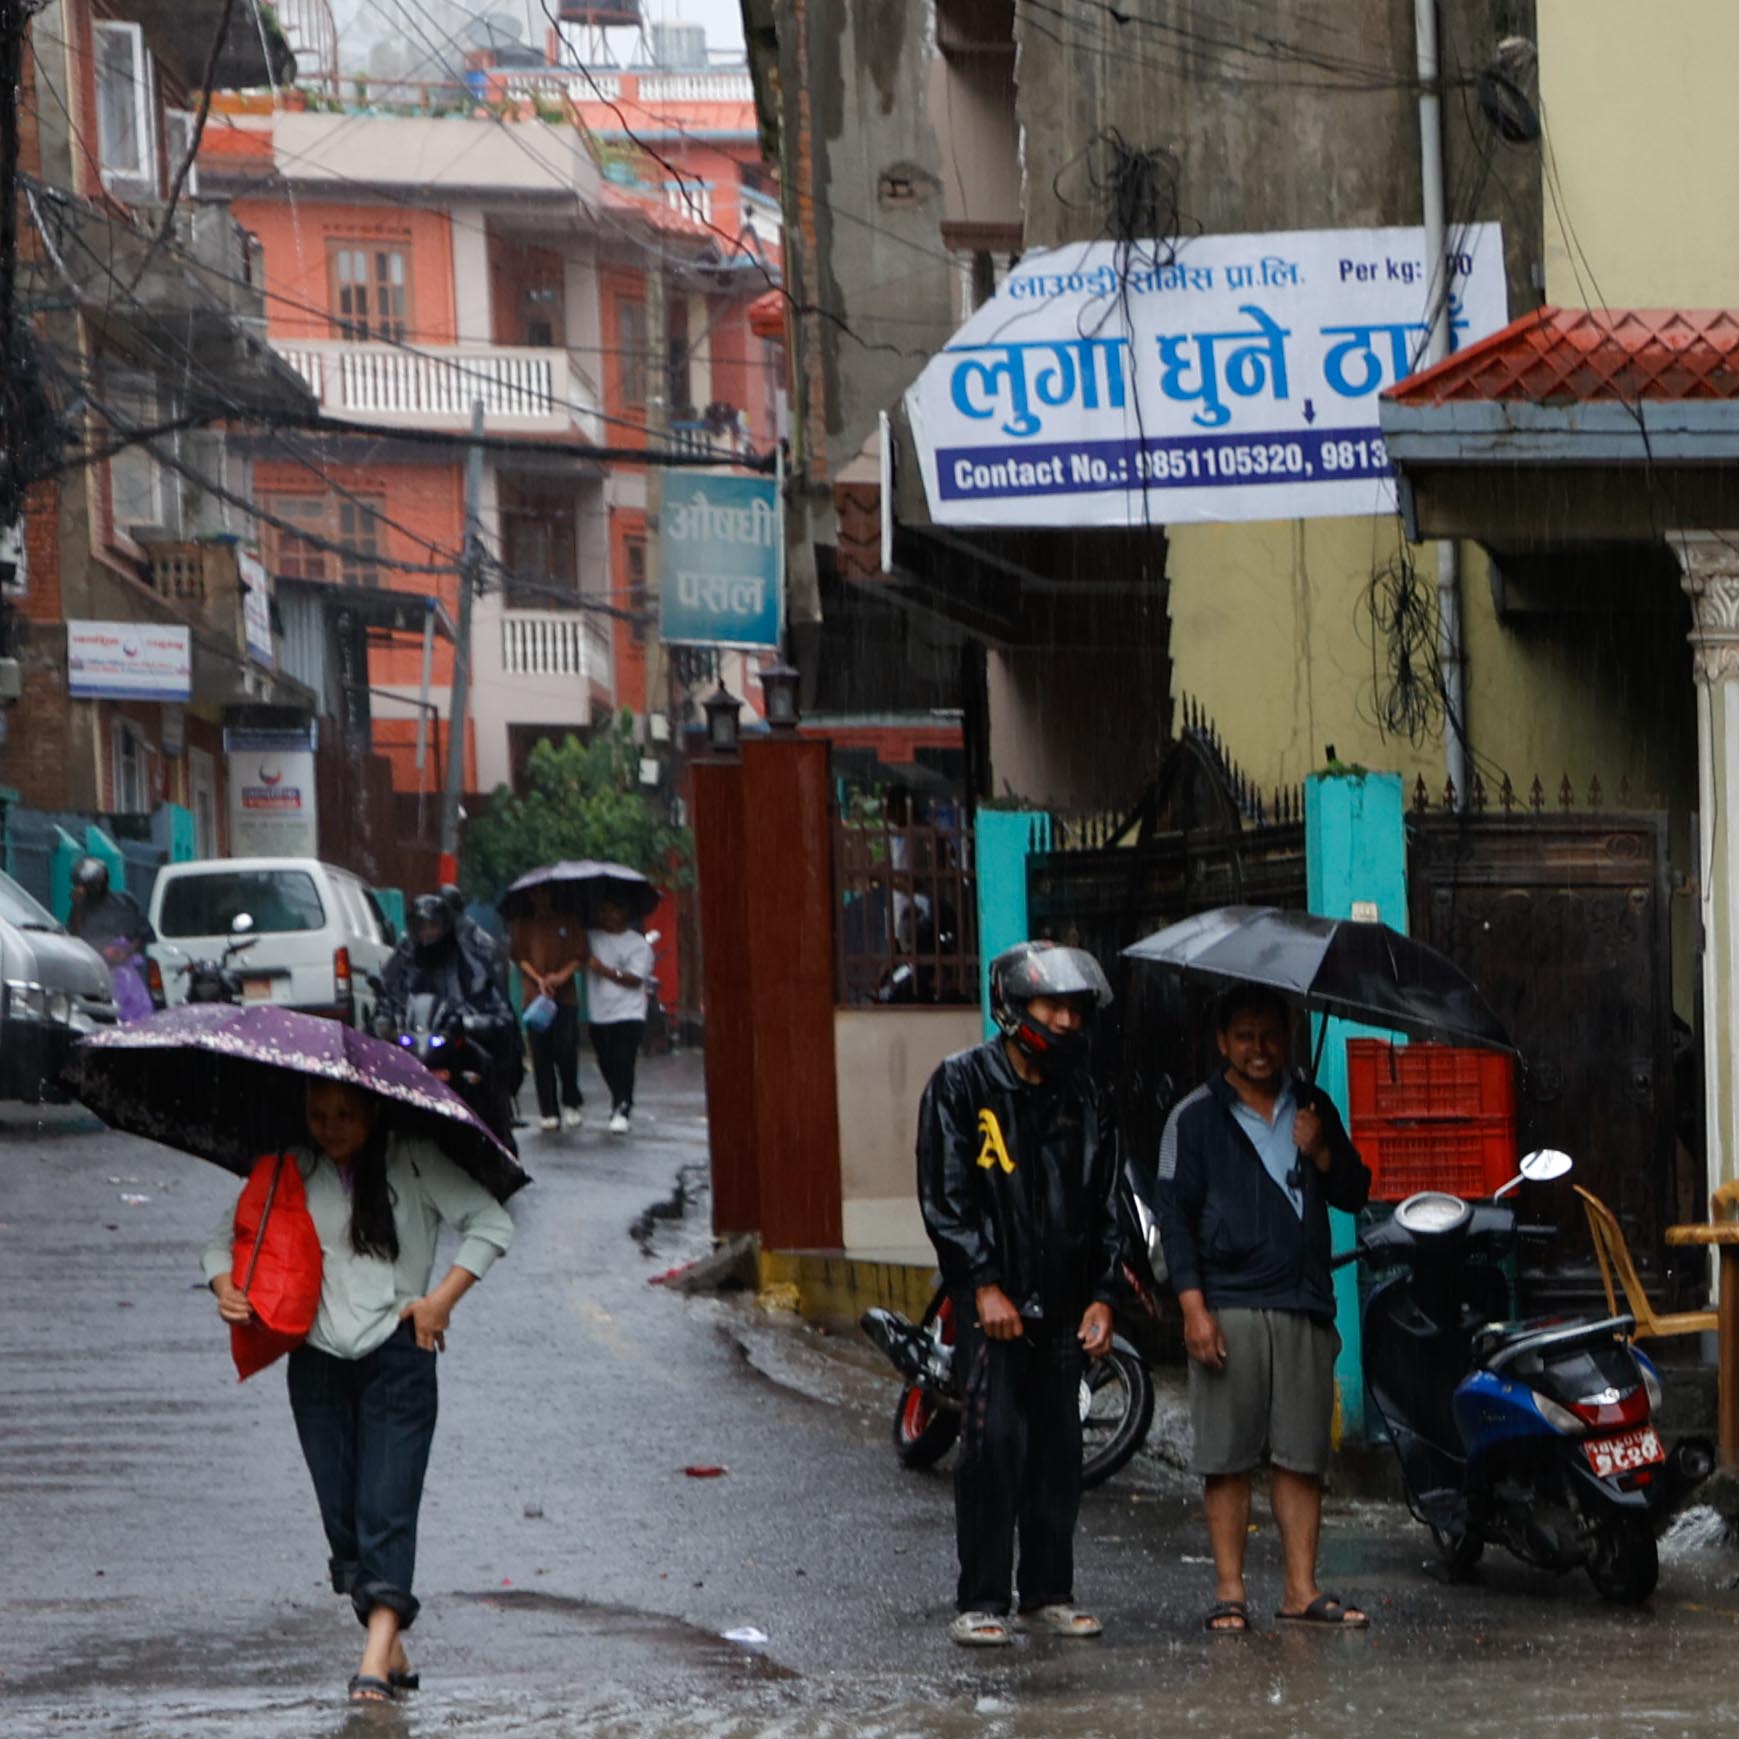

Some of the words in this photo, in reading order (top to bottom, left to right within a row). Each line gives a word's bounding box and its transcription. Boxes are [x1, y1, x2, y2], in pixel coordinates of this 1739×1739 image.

[1339, 259, 1378, 282] Per
[1386, 258, 1422, 284] kg:
[943, 337, 1129, 437] लुगा
[1156, 304, 1292, 428] धुने
[953, 456, 1064, 491] Contact
[1071, 453, 1128, 483] No.:
[1135, 443, 1313, 479] 9851105320,
[1320, 438, 1389, 472] 9813
[667, 490, 777, 546] औषधी
[677, 571, 766, 615] पसल
[976, 1106, 1017, 1176] A
